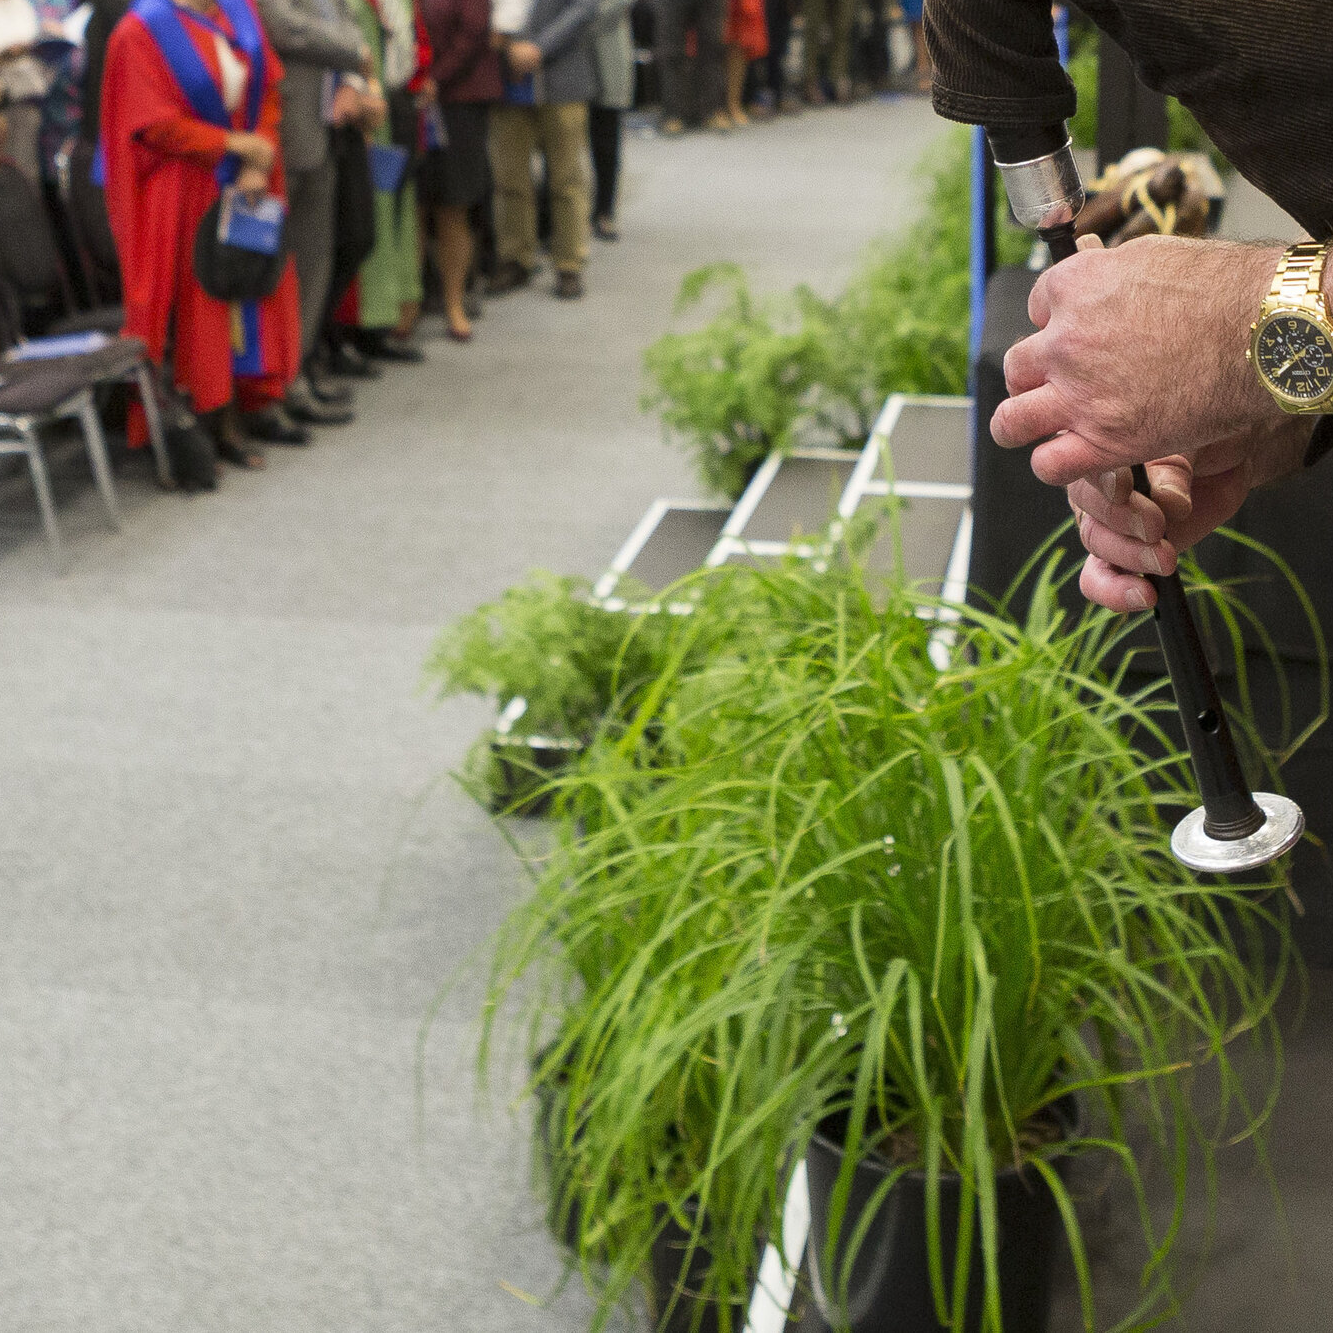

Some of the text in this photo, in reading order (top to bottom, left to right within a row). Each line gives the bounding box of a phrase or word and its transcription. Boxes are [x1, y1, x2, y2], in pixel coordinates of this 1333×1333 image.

[1287, 321, 1297, 330] 6
[1265, 339, 1275, 347] 4
[1315, 336, 1326, 346] 8
[1316, 367, 1330, 377] 10
[1296, 381, 1310, 392] 12
